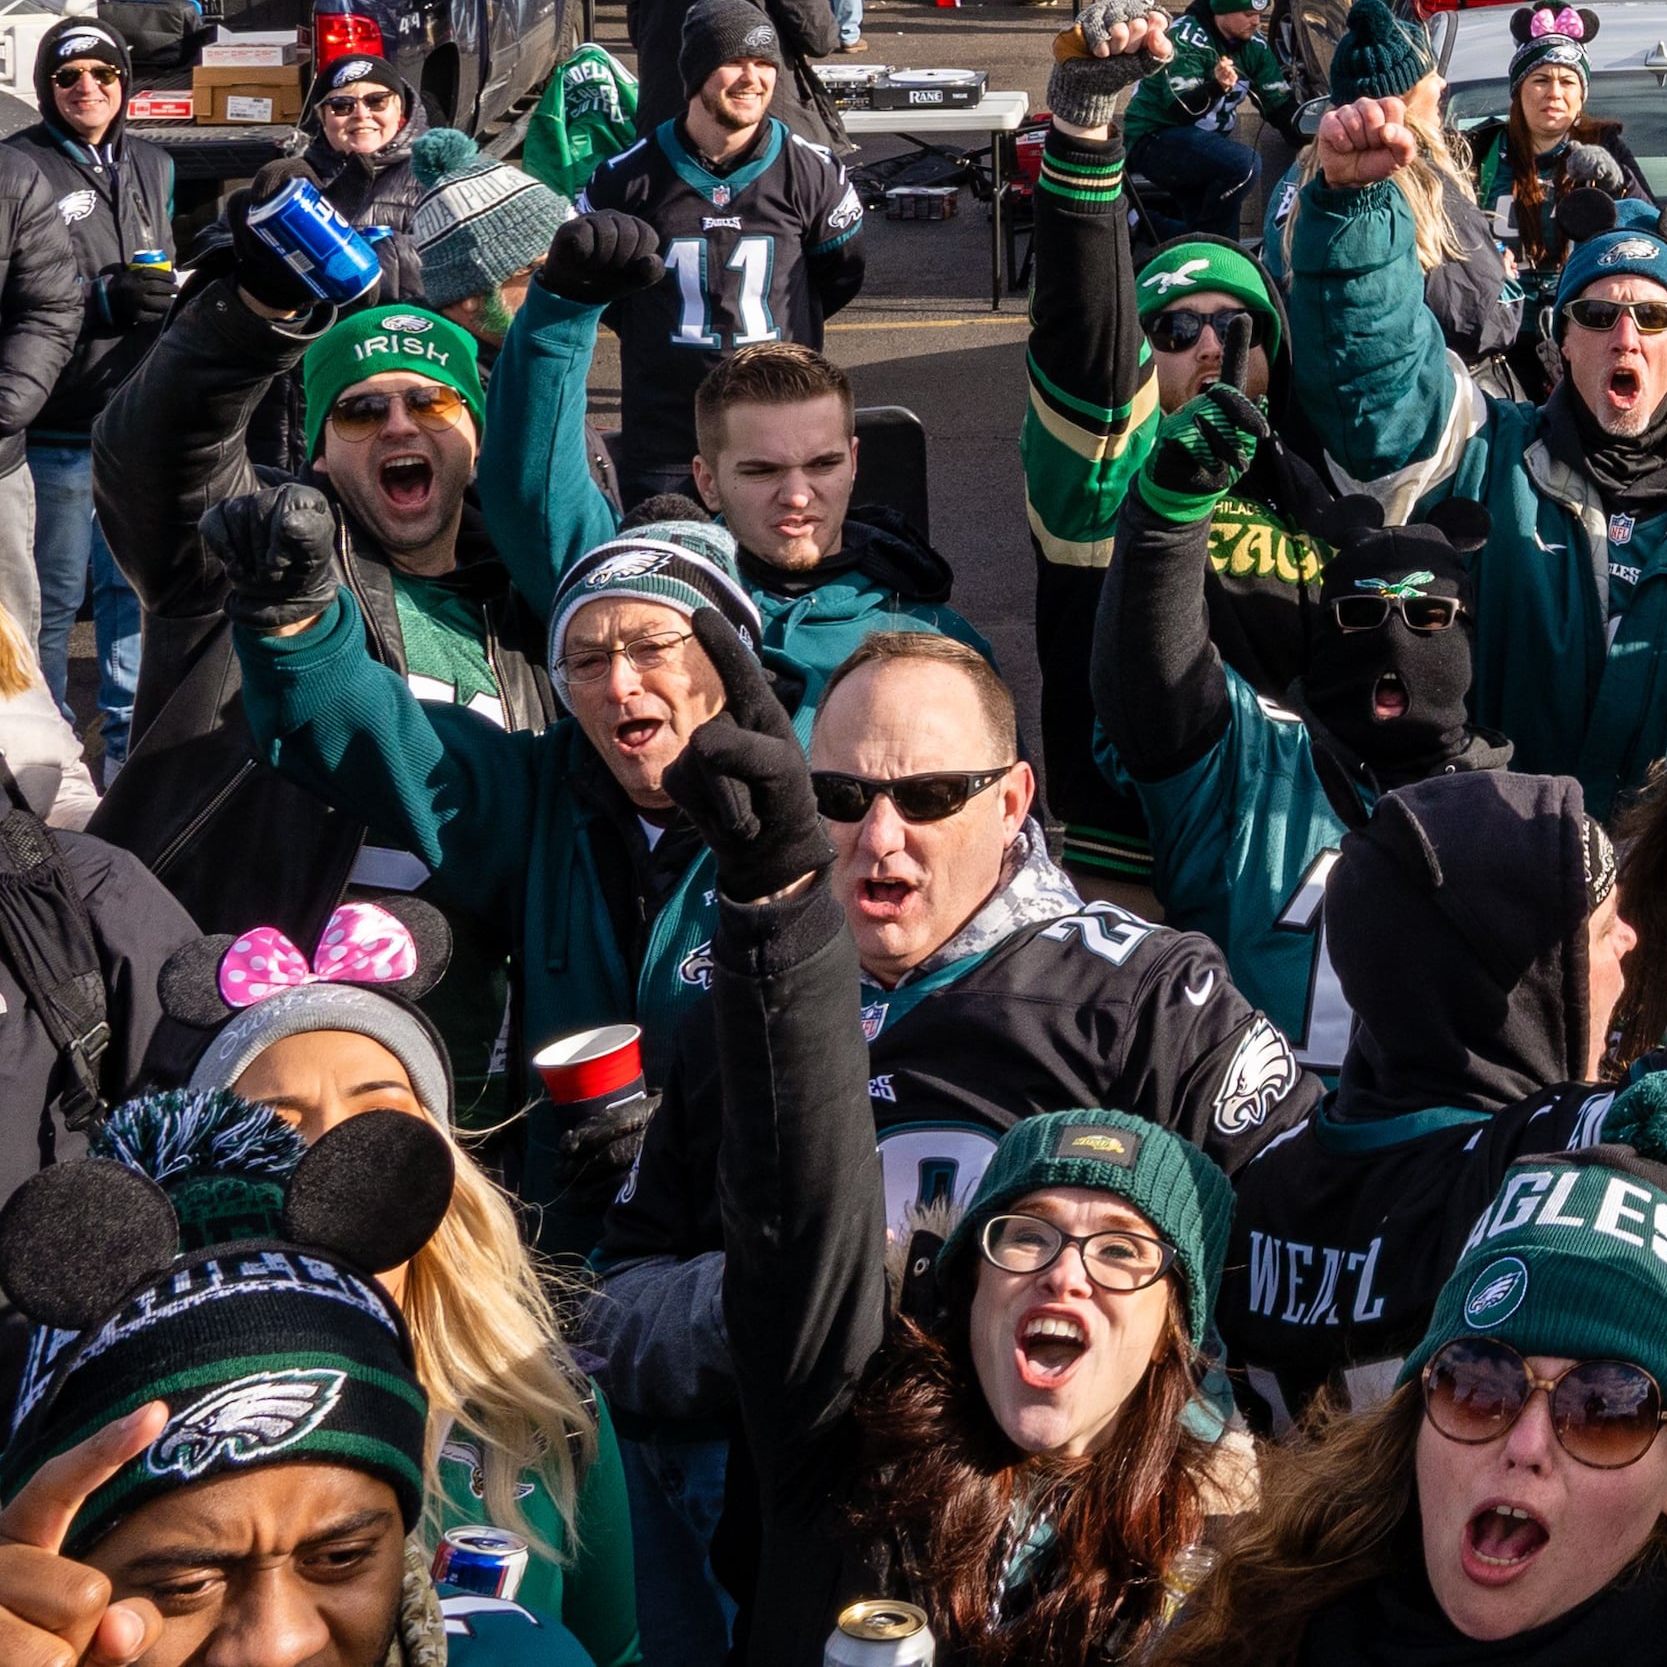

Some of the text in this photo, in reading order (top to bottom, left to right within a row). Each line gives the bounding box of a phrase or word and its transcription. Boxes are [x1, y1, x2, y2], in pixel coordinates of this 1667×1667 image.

[909, 90, 943, 103] RANE
[702, 216, 743, 231] EAGLES
[664, 237, 782, 344] 11
[353, 334, 450, 367] IRISH
[1610, 526, 1628, 541] NFL
